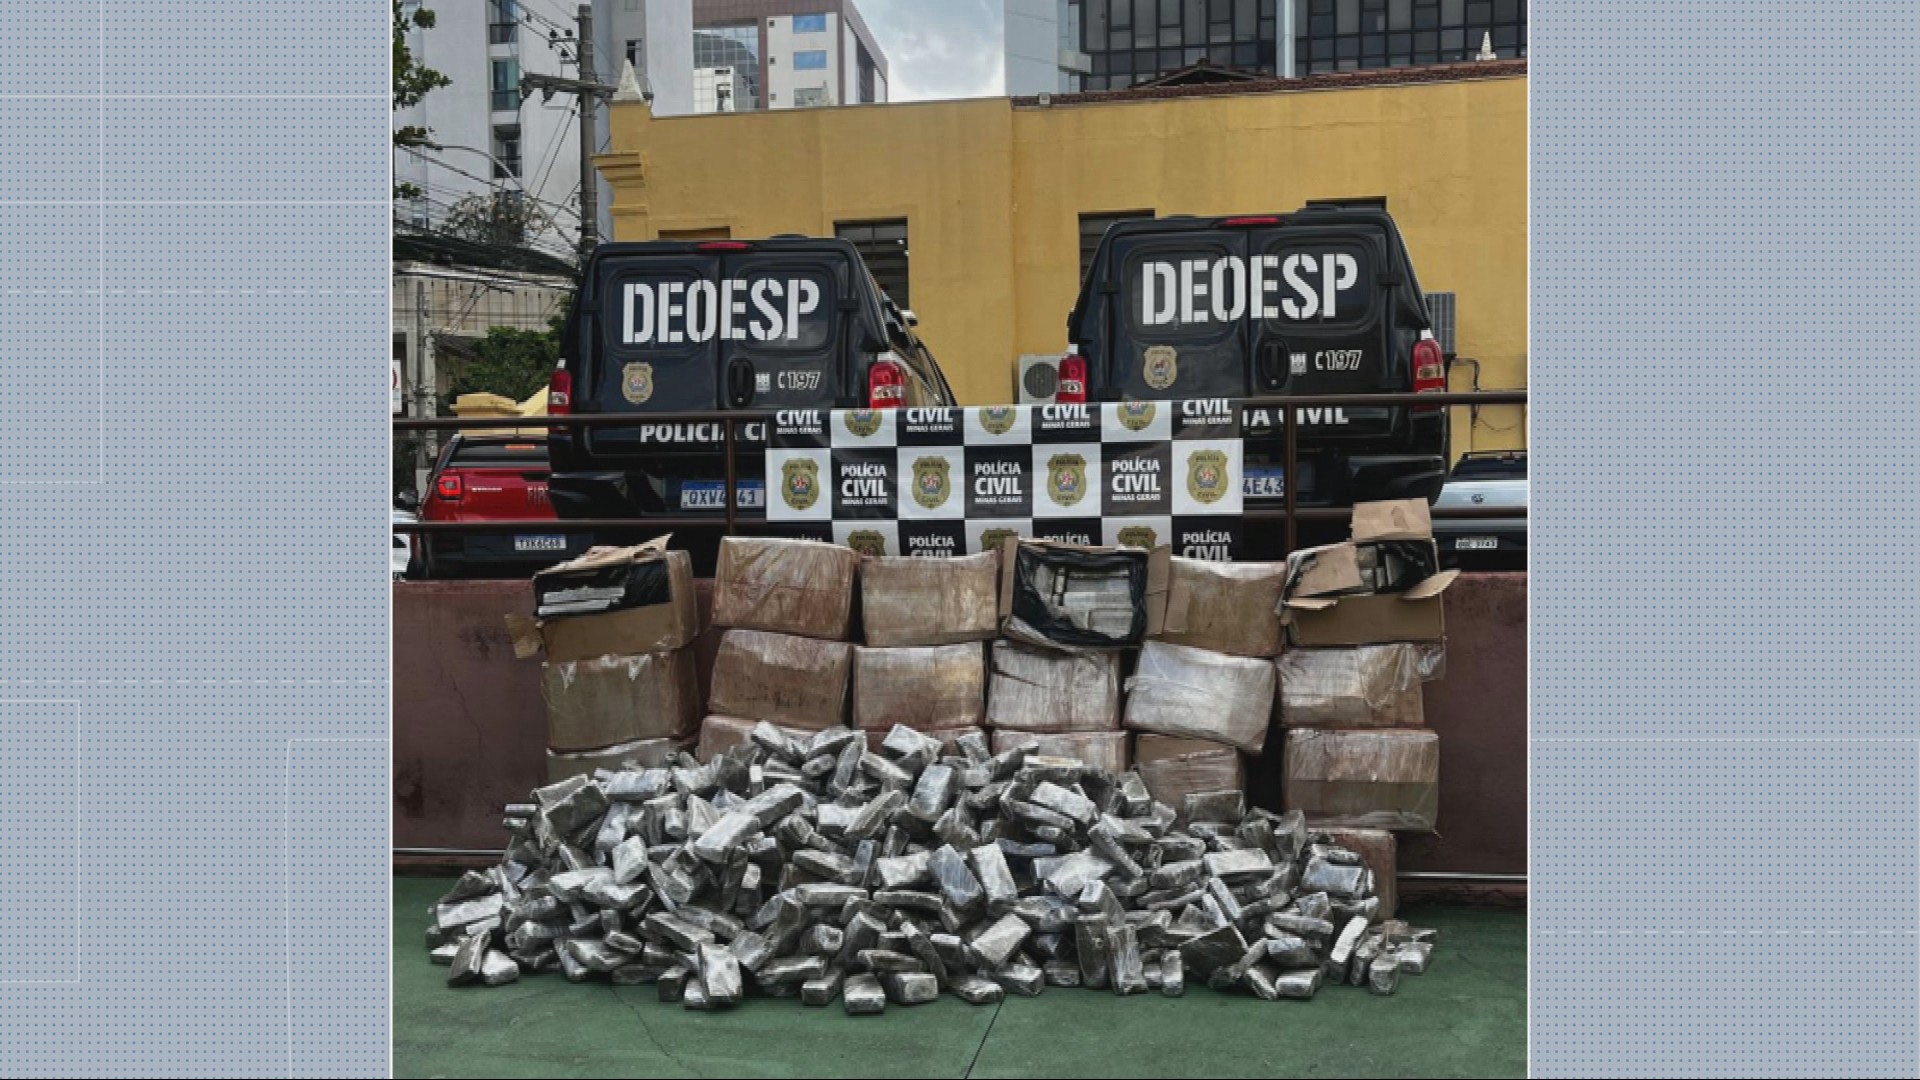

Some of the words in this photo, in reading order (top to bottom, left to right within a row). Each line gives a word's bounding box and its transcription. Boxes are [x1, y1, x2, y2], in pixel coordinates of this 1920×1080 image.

[1142, 254, 1358, 325] DEOESP
[622, 279, 820, 344] DEOESP
[1042, 404, 1090, 420] CIVIL
[1182, 400, 1232, 415] CIVIL
[776, 410, 821, 425] CIVIL
[906, 409, 953, 422] CIVIL
[1208, 416, 1232, 424] GERAIS
[841, 462, 887, 476] POLÍCIA
[975, 460, 1021, 475] POLÍCIA
[1112, 456, 1160, 472] POLÍCIA
[841, 480, 888, 496] CIVIL
[975, 478, 1022, 494] CIVIL
[1112, 475, 1160, 492] CIVIL
[1243, 478, 1284, 495] 4E43
[689, 490, 756, 505] QXW441
[909, 534, 956, 546] POLÍCIA
[1183, 530, 1231, 542] POLÍCIA
[1183, 546, 1232, 562] CIVIL
